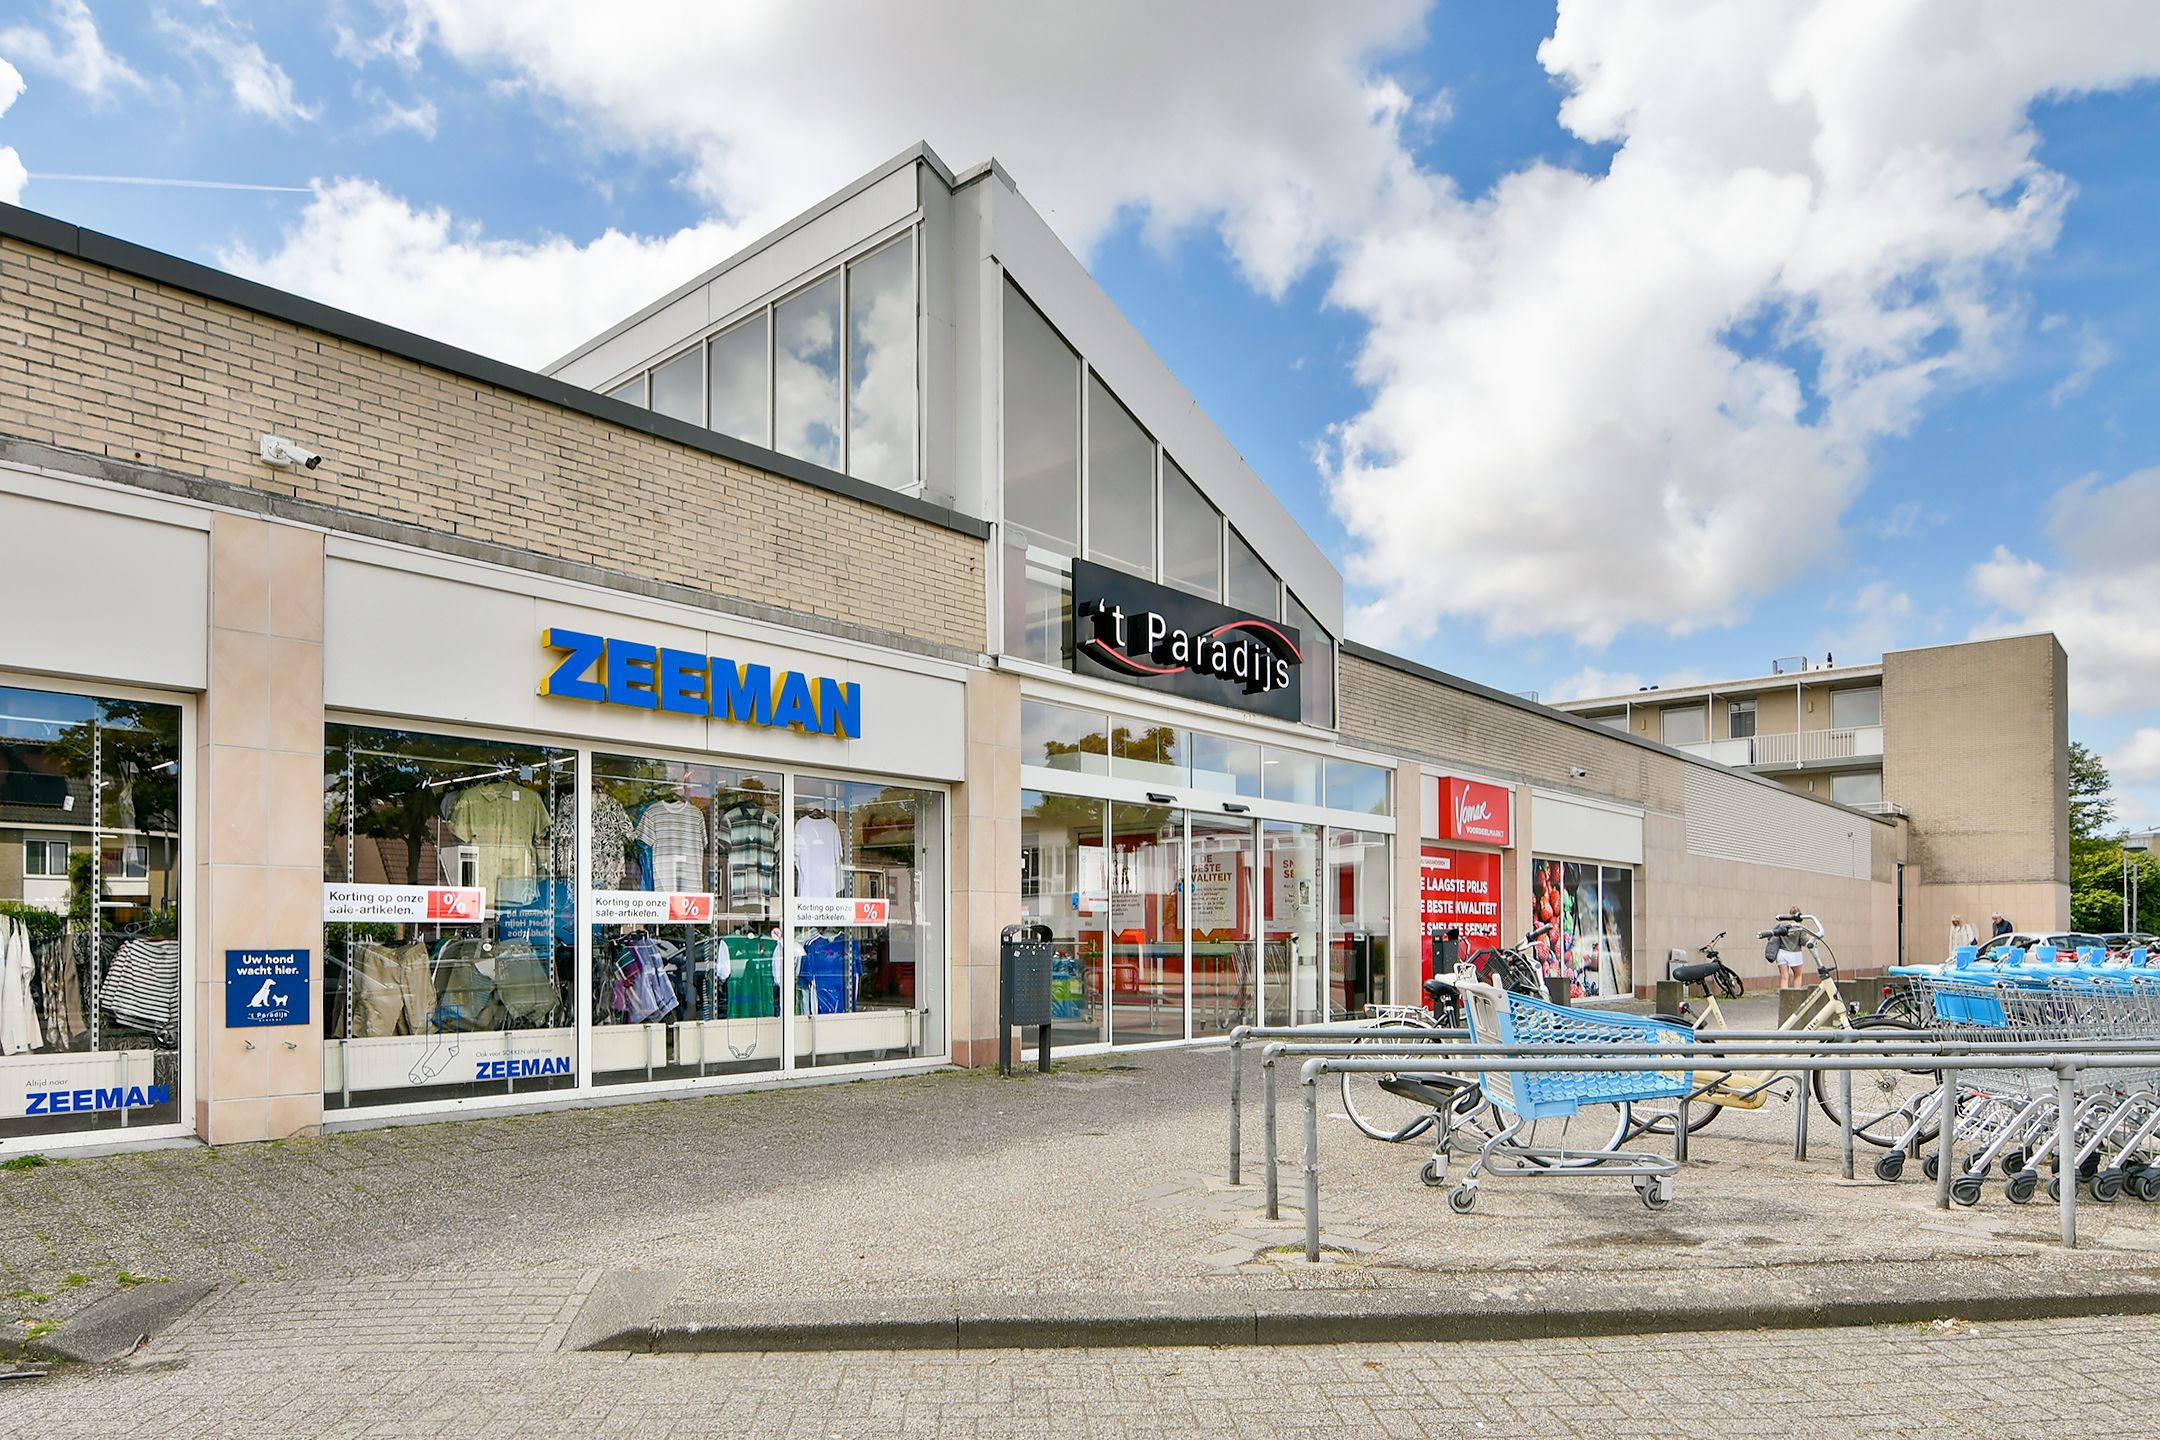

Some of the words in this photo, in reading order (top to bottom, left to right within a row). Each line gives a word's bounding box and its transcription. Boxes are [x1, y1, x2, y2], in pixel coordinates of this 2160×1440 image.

[1147, 611, 1290, 692] Paradijs
[541, 627, 861, 740] ZEEMAN
[1455, 784, 1492, 835] Vomar
[1465, 825, 1505, 838] VOORDEELMARKT
[1426, 877, 1465, 892] LAAGSTE
[1466, 879, 1488, 894] PRIJS
[328, 891, 374, 904] Korting
[374, 894, 393, 904] op
[396, 893, 425, 903] onze
[595, 897, 630, 908] Korting
[632, 900, 644, 908] op
[645, 899, 667, 907] onze
[328, 904, 414, 915] sale-artikelen.
[595, 908, 660, 918] sale-artikelen.
[797, 903, 824, 912] Korting
[1426, 900, 1454, 914] BESTE
[1455, 901, 1497, 916] KWALITEIT
[797, 912, 847, 921] sale-artikelen.
[242, 954, 263, 965] Uw
[265, 953, 295, 964] hond
[236, 965, 273, 975] wacht
[274, 965, 300, 975] hier.
[475, 1050, 487, 1058] Ook
[475, 1056, 570, 1080] ZEEMAN
[25, 1079, 47, 1088] Altijd
[25, 1083, 171, 1115] ZEEMAN
